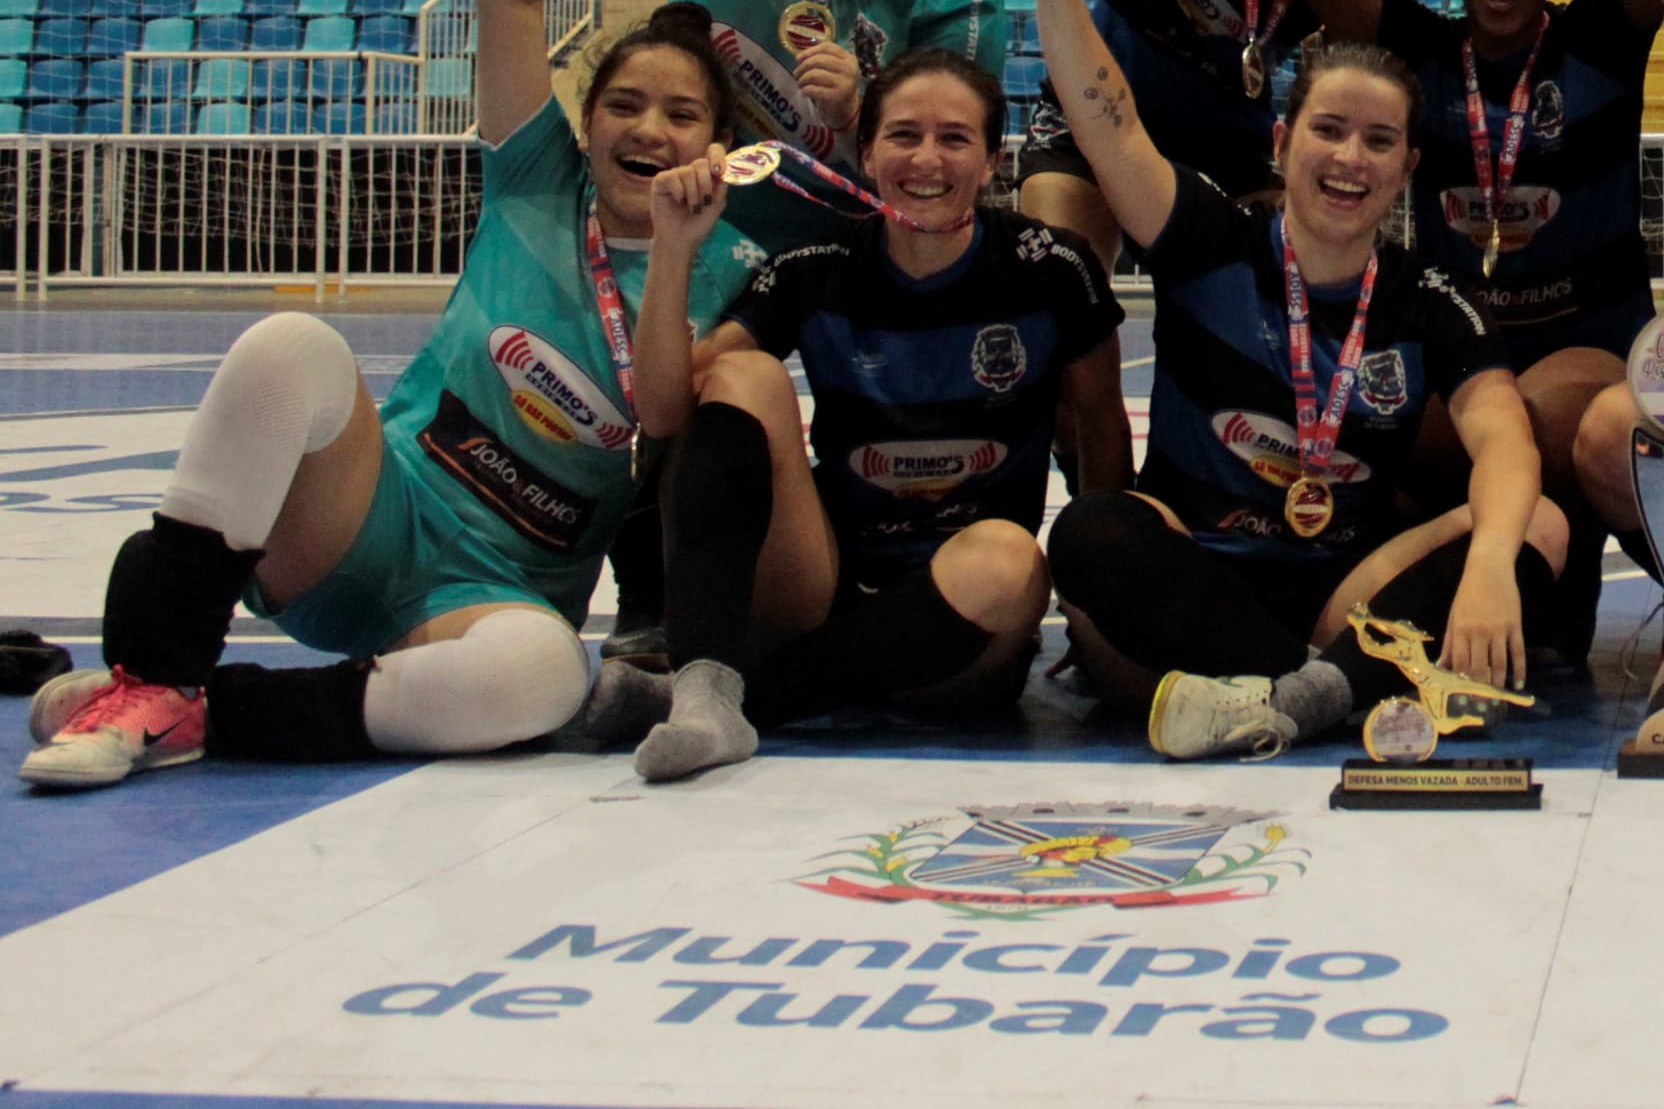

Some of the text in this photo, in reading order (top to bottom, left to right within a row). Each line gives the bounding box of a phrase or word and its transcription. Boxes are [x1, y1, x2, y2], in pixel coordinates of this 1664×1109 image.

[529, 360, 599, 427] PRIMO'S
[469, 441, 518, 485] JOÃO
[520, 483, 582, 526] FILHO
[893, 454, 965, 475] PRIMO'S
[1349, 774, 1385, 787] DEFESA
[1385, 774, 1419, 787] MENOS
[1420, 774, 1459, 787] VAZADA
[1465, 775, 1502, 787] ADULTO
[505, 924, 1401, 989] Município
[341, 971, 1452, 1045] de Tubarão
